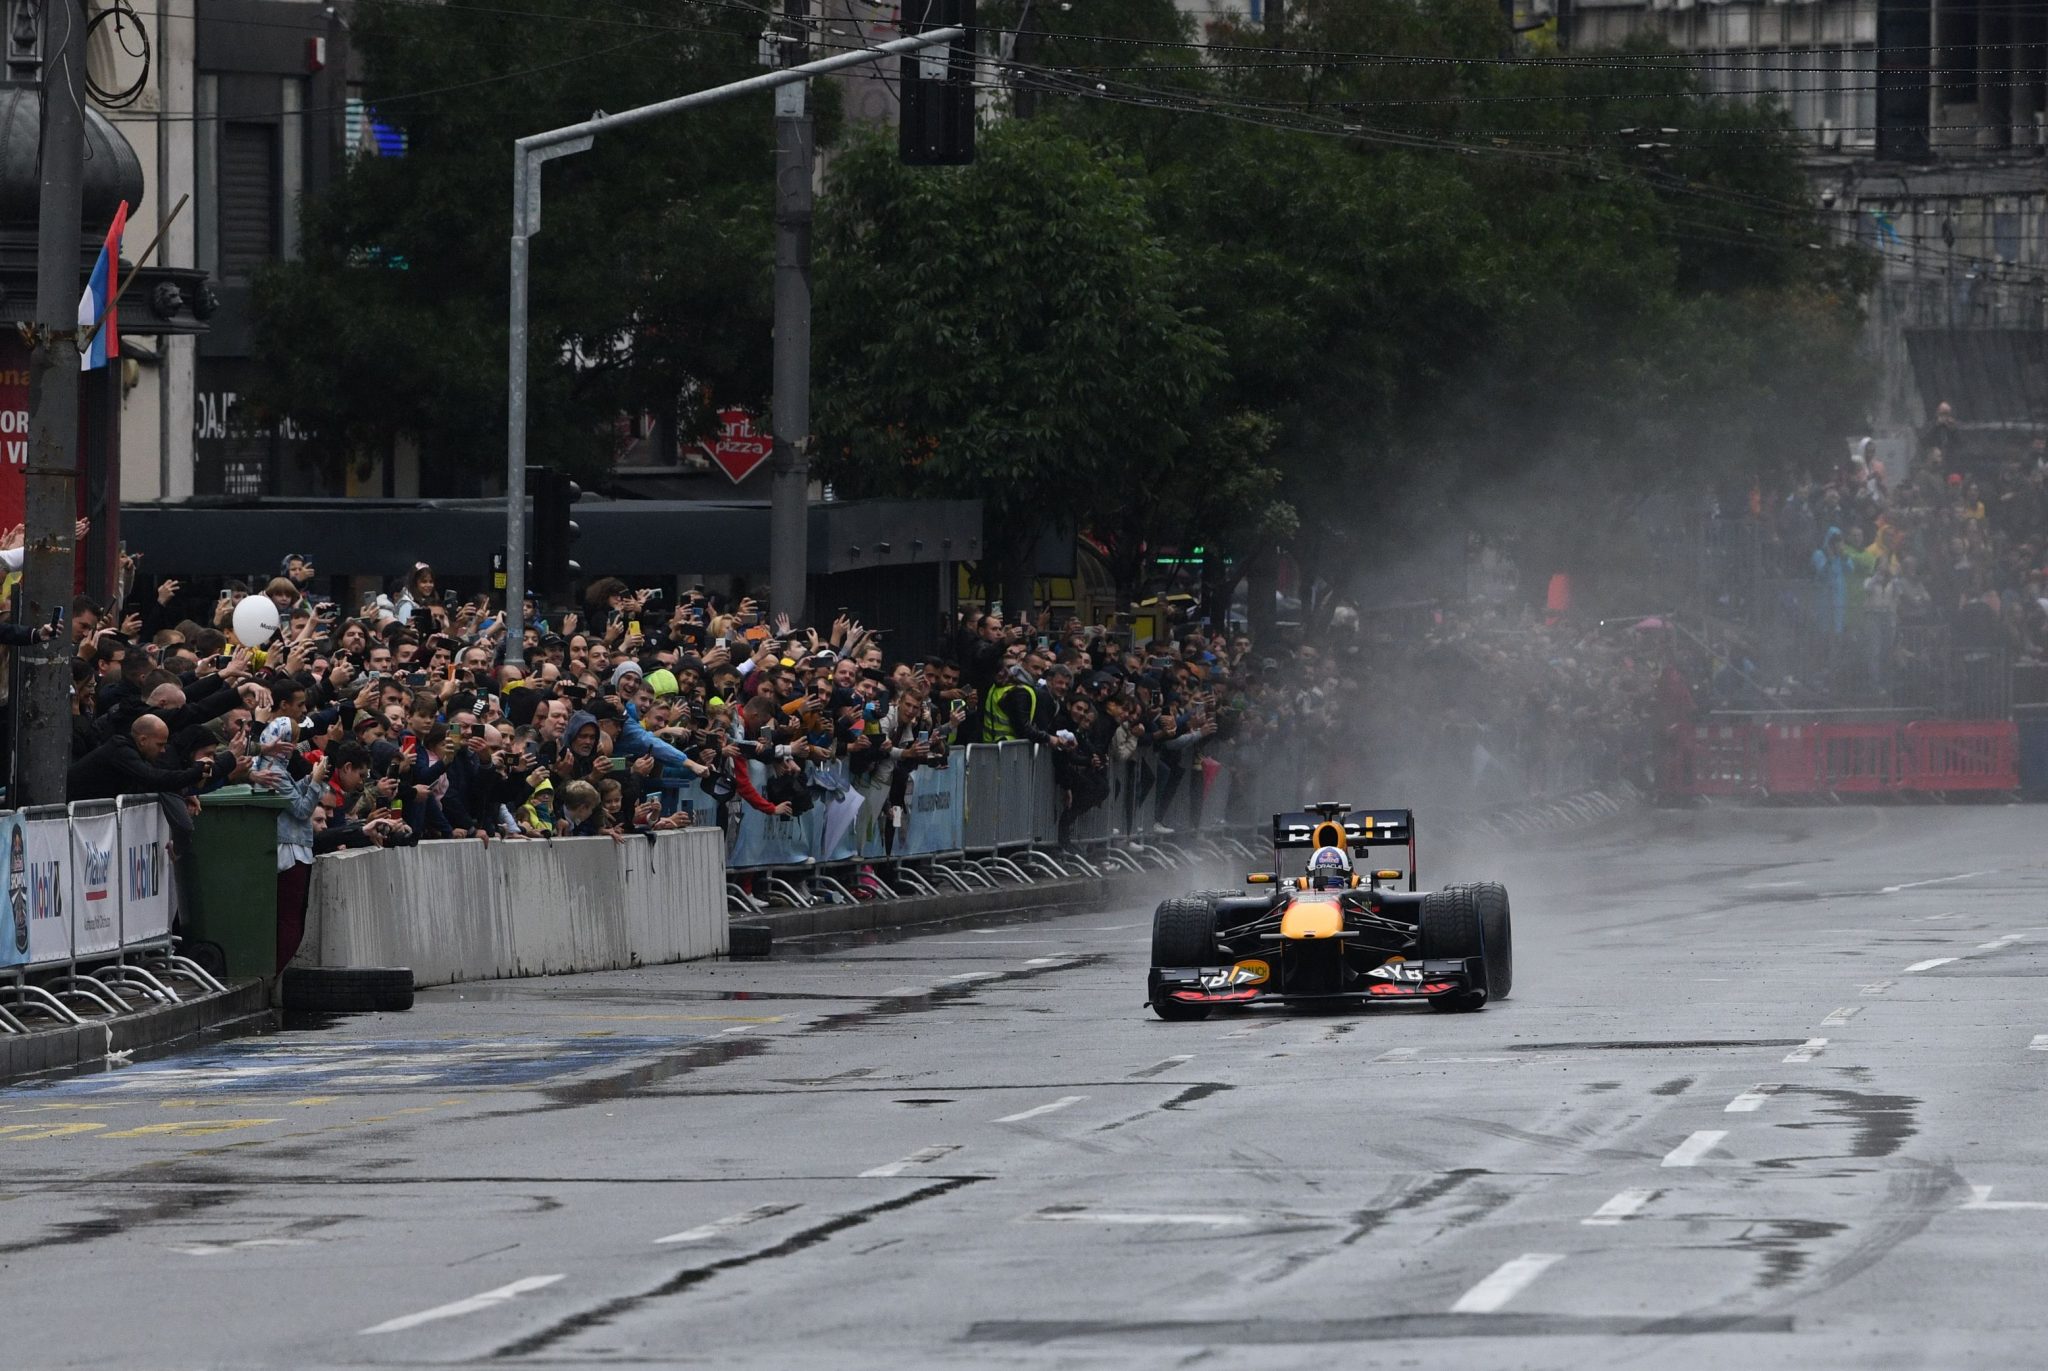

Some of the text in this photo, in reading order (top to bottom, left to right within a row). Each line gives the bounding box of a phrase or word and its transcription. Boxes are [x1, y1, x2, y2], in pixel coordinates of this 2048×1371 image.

[0, 410, 29, 433] OR
[715, 438, 763, 455] pizza
[1288, 816, 1398, 842] BBIT
[129, 843, 151, 902] Mobil
[31, 862, 53, 920] Mobil
[1367, 963, 1424, 981] BYB
